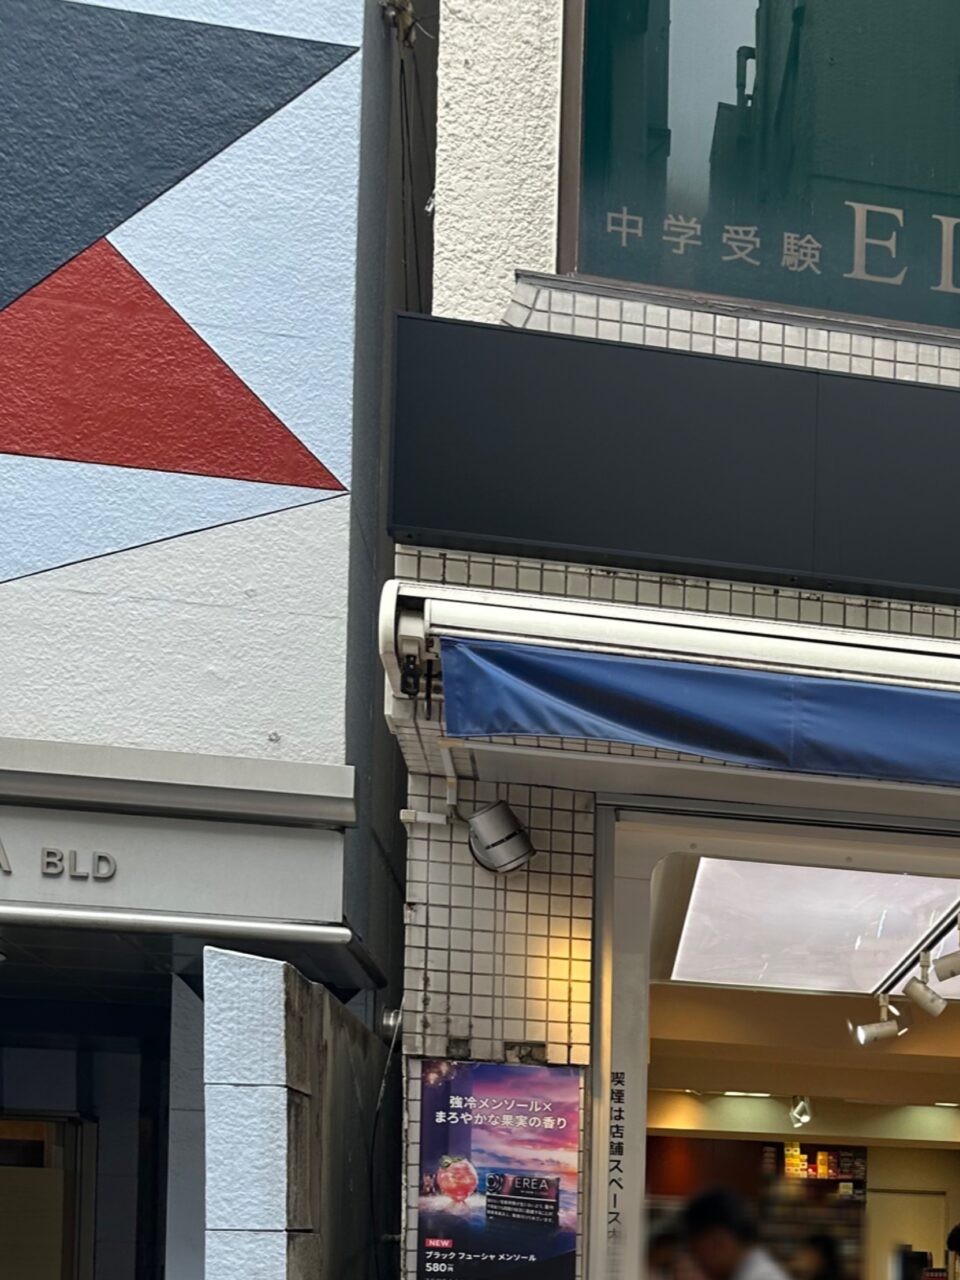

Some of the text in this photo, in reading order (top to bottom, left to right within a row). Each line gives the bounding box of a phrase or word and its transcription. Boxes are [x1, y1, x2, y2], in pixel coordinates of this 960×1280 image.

[605, 206, 823, 275] 中学受験
[42, 847, 117, 881] BLD
[449, 1095, 552, 1112] 強冷メンソール×
[434, 1110, 567, 1129] まろやかな果実の香り
[425, 1250, 456, 1259] ブラック
[498, 1253, 537, 1262] メンソール
